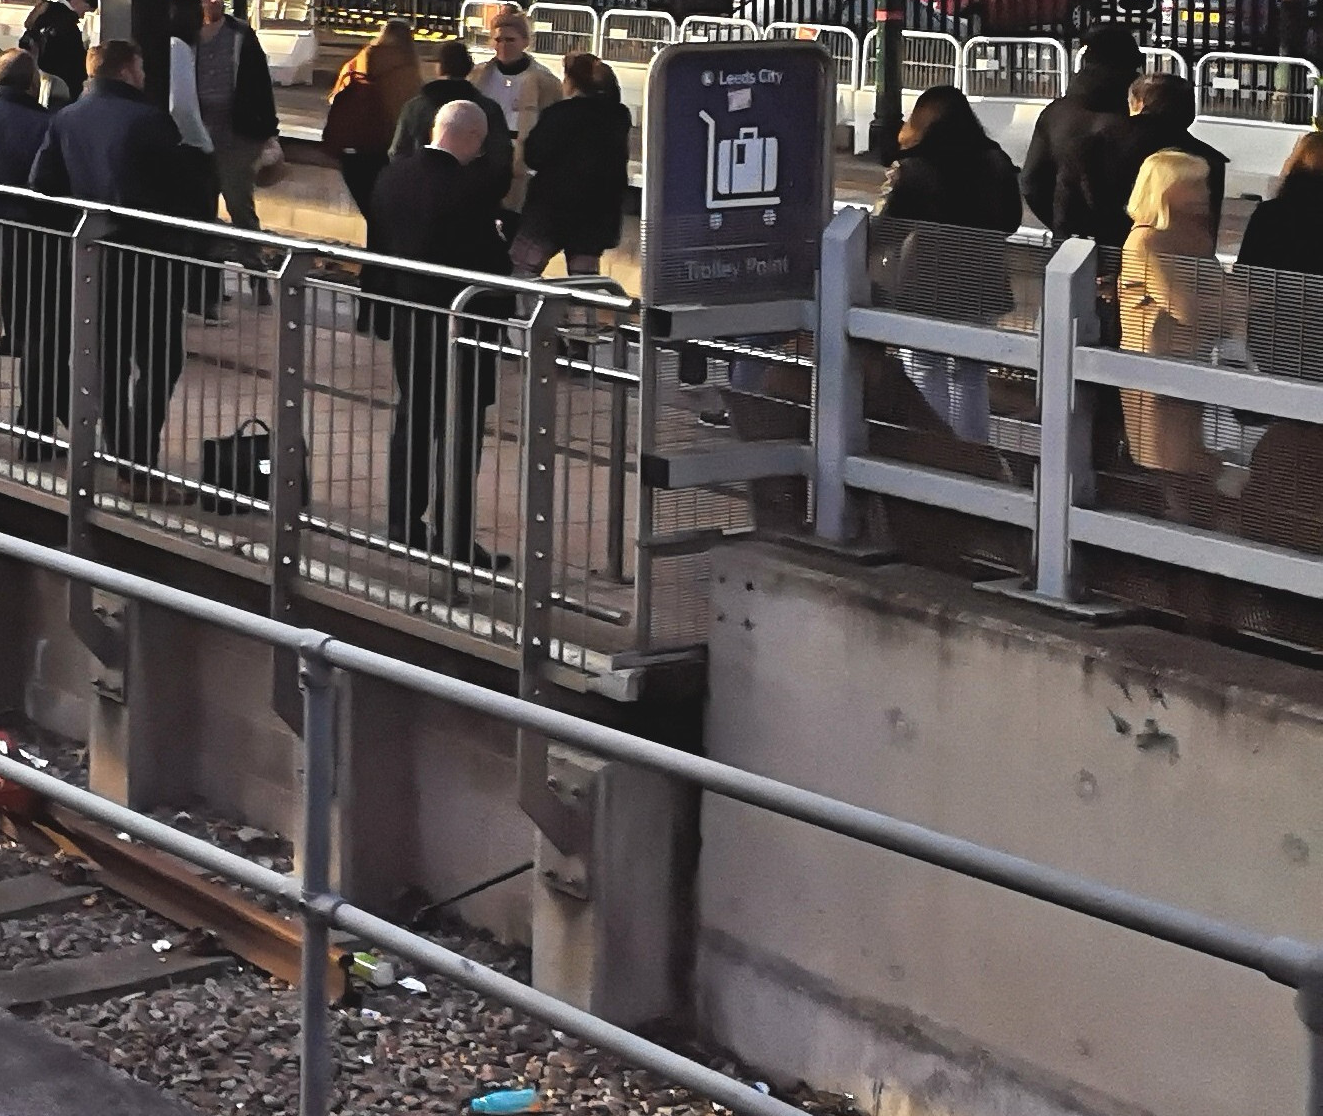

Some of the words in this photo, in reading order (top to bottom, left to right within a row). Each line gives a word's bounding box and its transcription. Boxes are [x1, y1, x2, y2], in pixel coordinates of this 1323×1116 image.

[719, 70, 756, 85] Leeds
[758, 69, 783, 86] City
[685, 258, 741, 281] Trolley
[746, 255, 789, 276] Point
